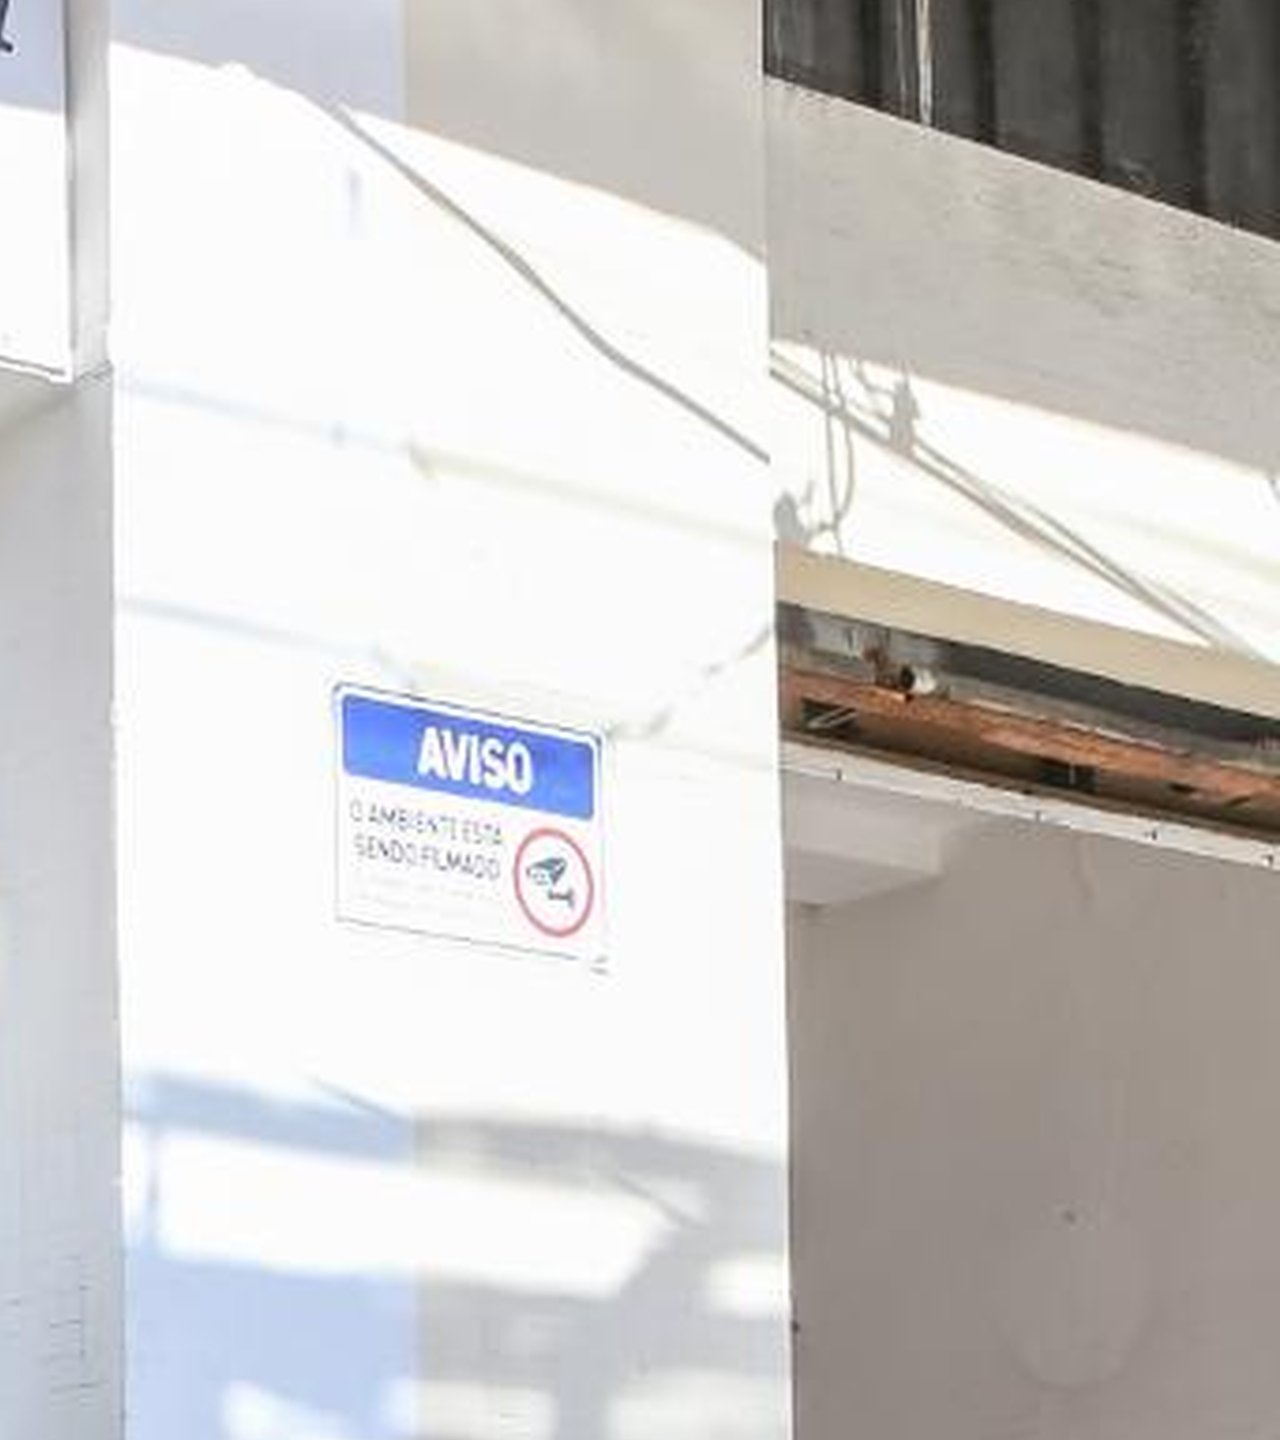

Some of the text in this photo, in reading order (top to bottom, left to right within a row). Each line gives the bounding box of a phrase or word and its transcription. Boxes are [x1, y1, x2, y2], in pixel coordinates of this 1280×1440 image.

[416, 725, 534, 796] AVISO
[354, 833, 501, 881] SENDO FILMADO
